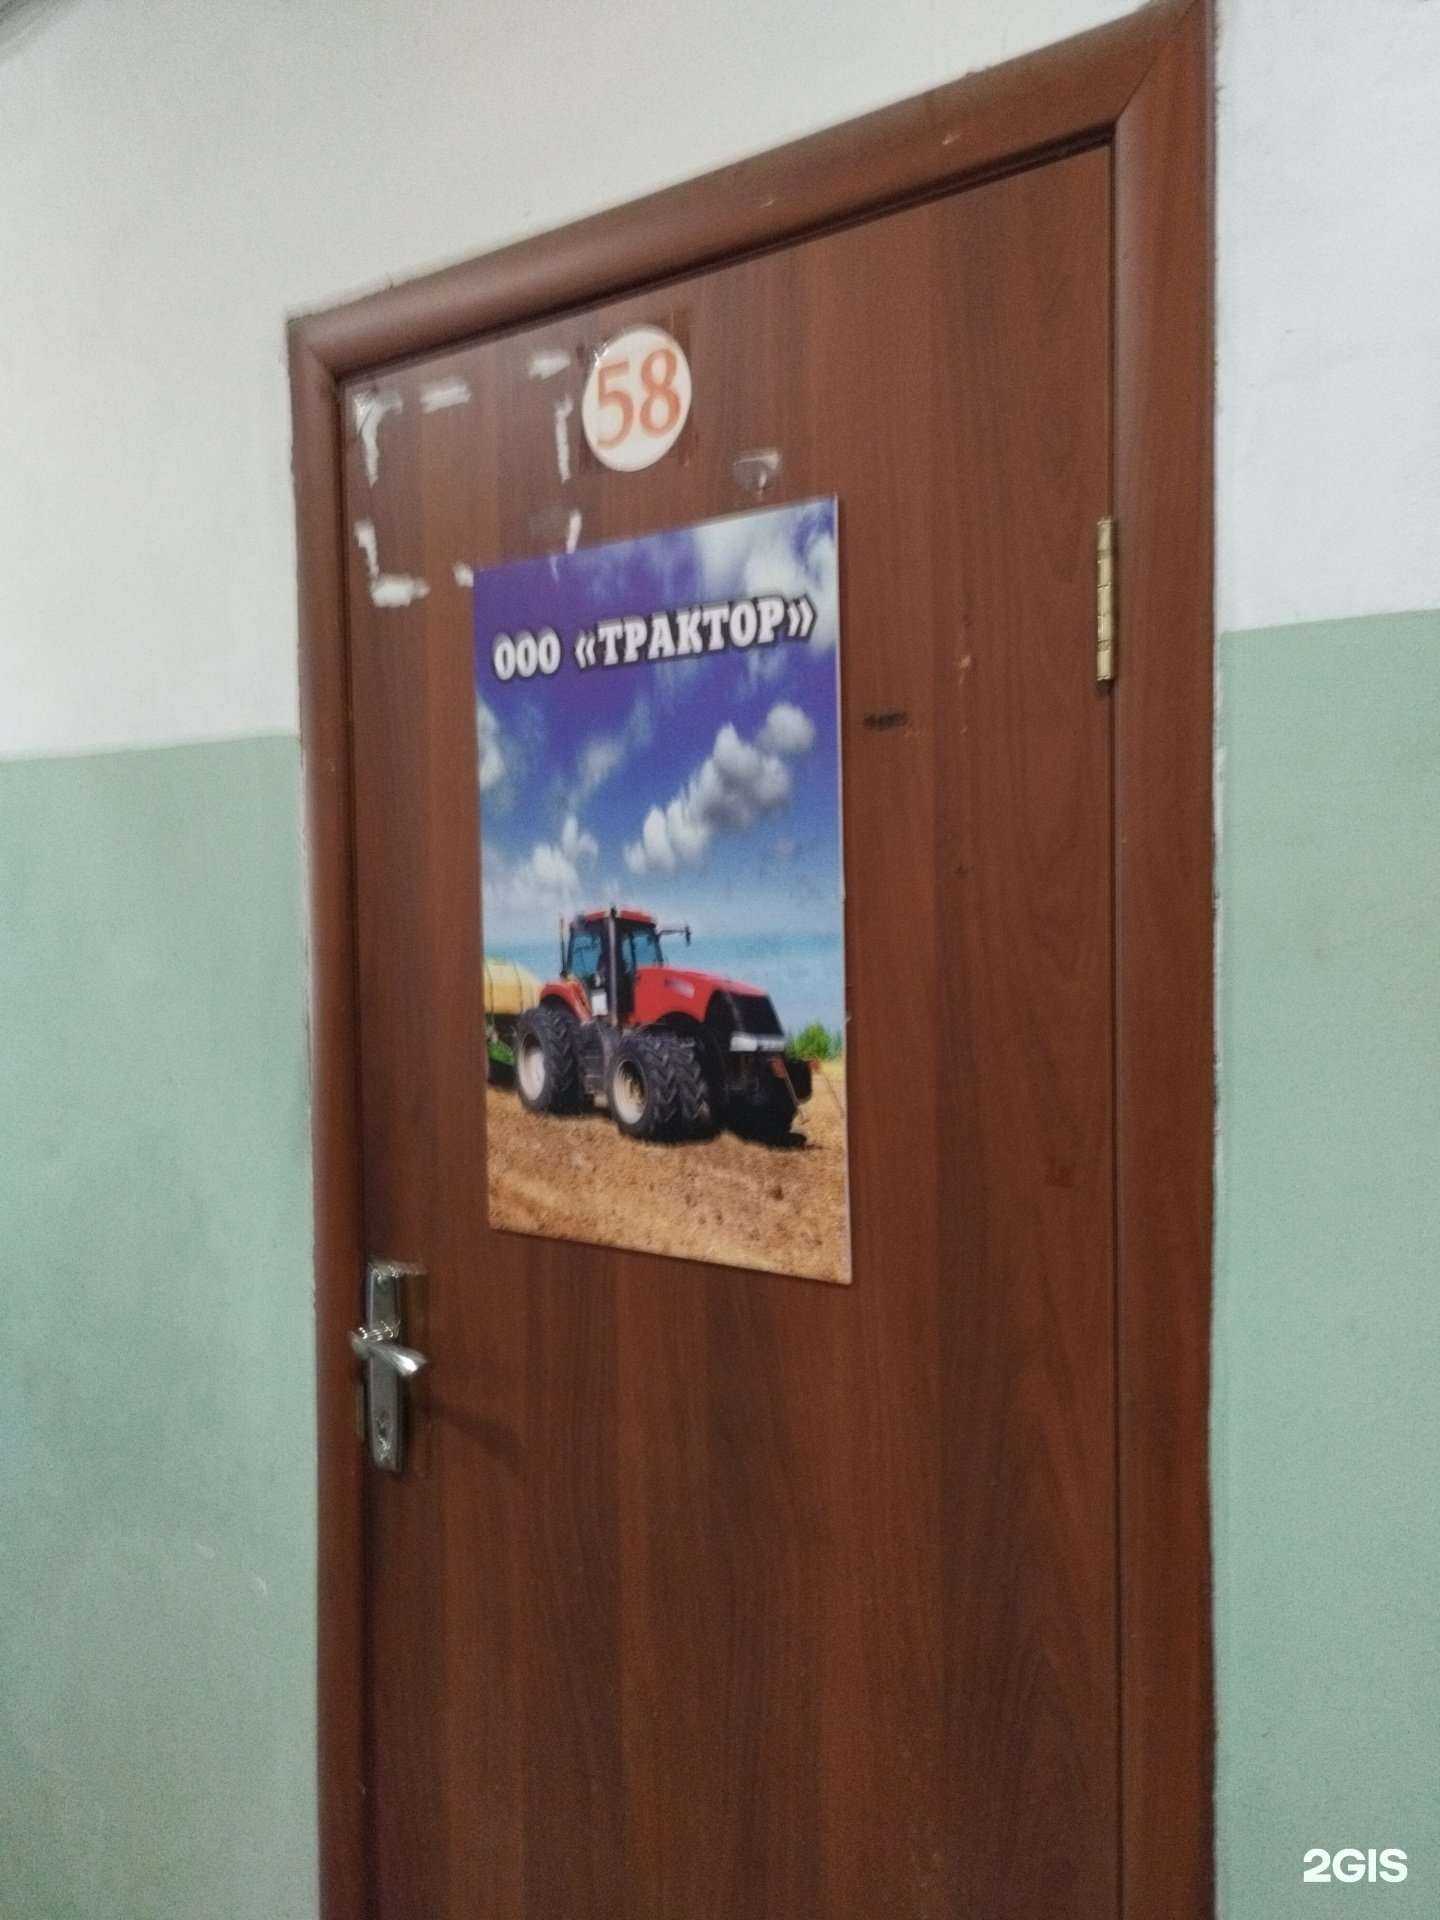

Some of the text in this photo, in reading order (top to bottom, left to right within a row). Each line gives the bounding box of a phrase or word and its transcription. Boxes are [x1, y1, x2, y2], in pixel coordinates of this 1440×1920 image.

[597, 348, 681, 449] 58
[493, 593, 817, 681] ООО «ТРАКТОР»
